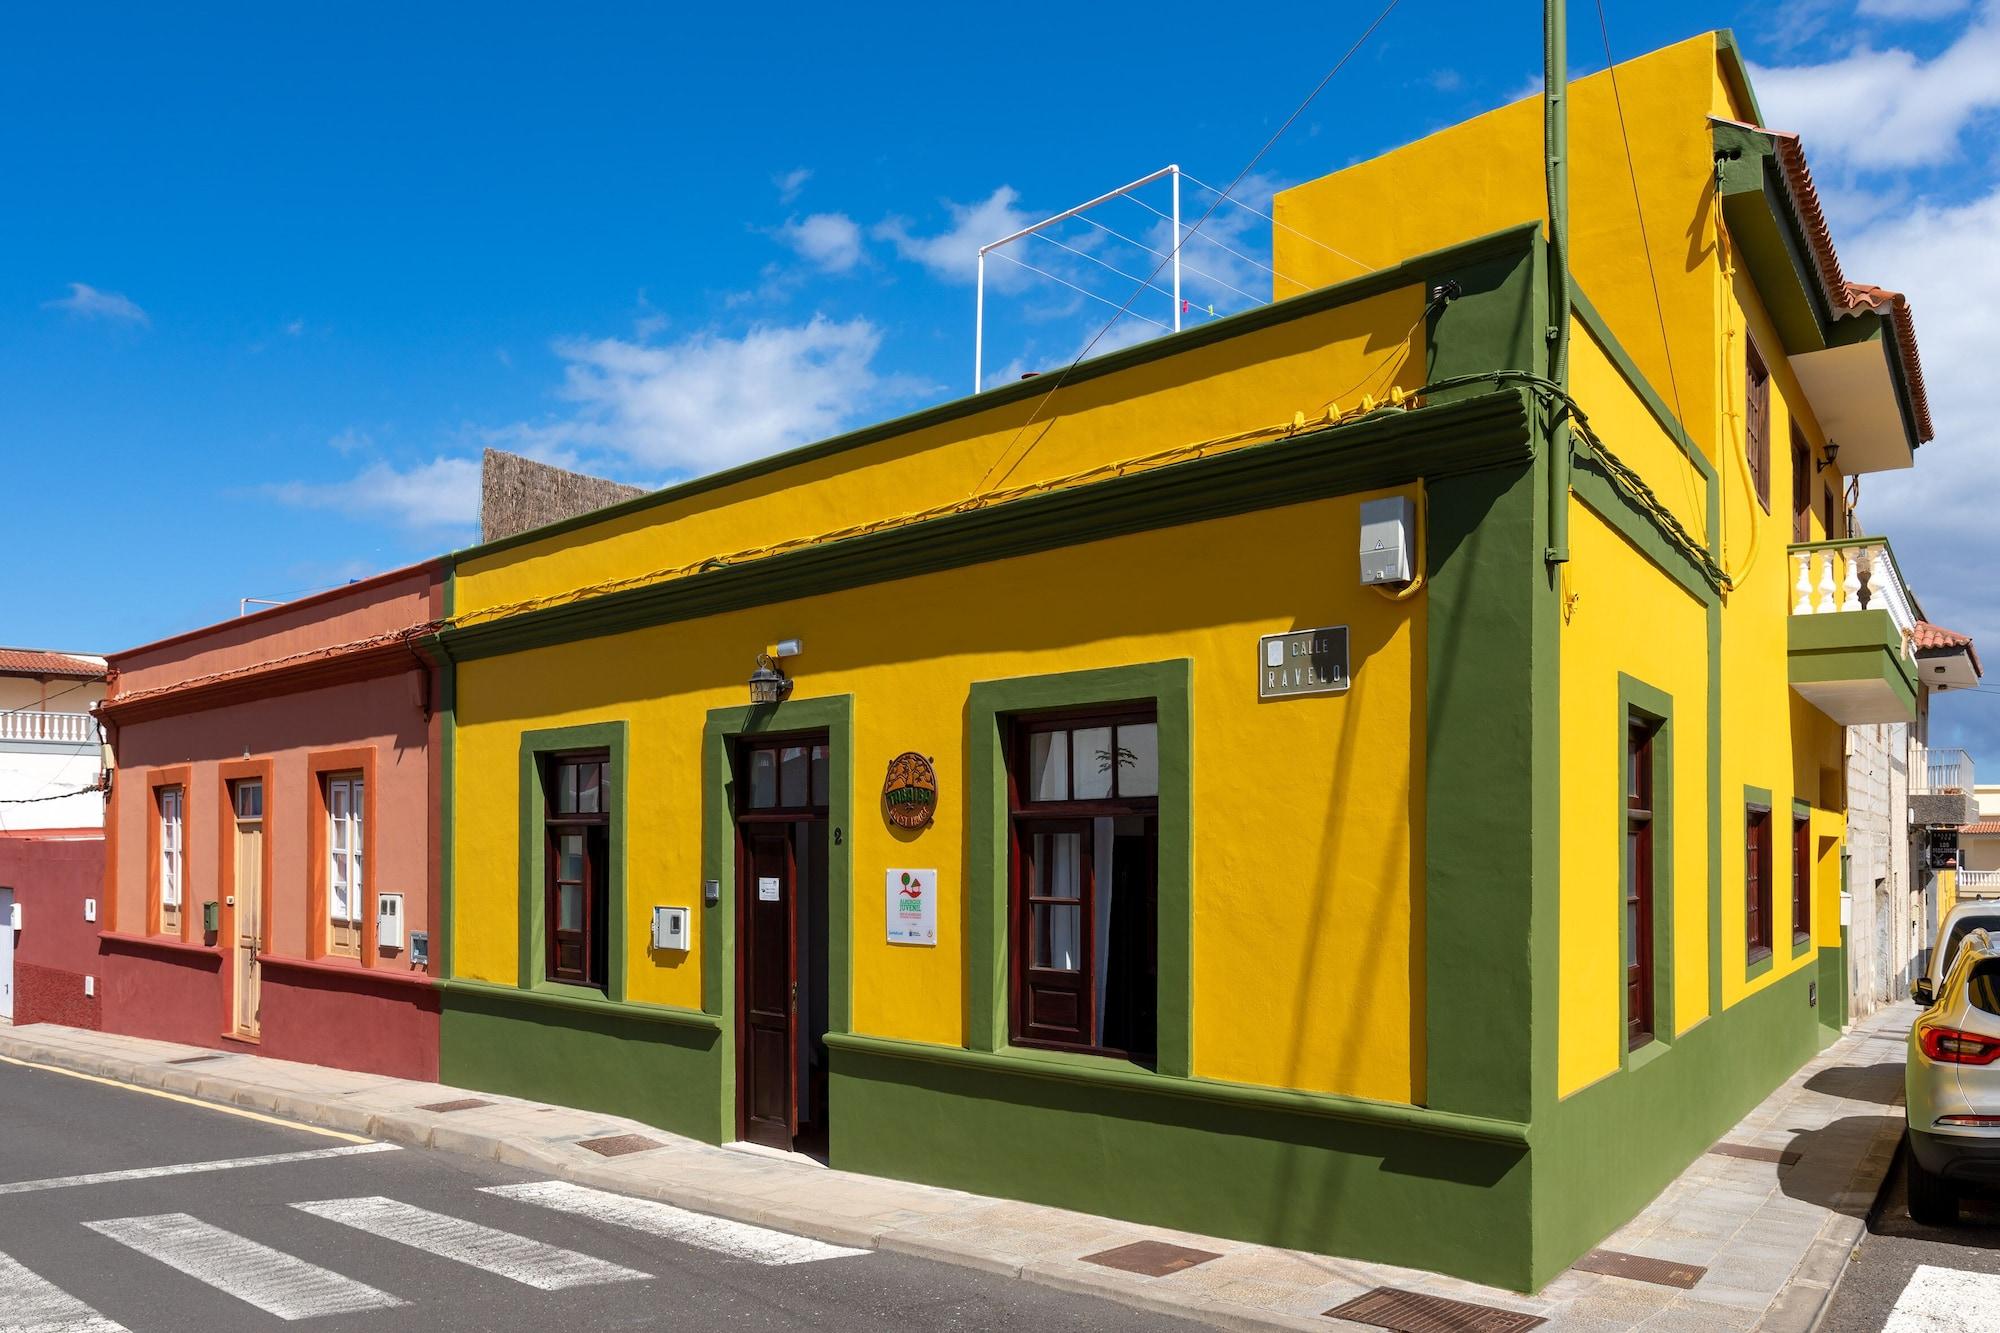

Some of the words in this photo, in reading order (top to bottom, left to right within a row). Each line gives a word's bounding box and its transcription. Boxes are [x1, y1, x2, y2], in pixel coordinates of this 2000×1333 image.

[1292, 639, 1328, 656] CALLE
[1268, 665, 1340, 688] RAVELO
[910, 806, 929, 826] HOUSE
[834, 827, 842, 846] 2
